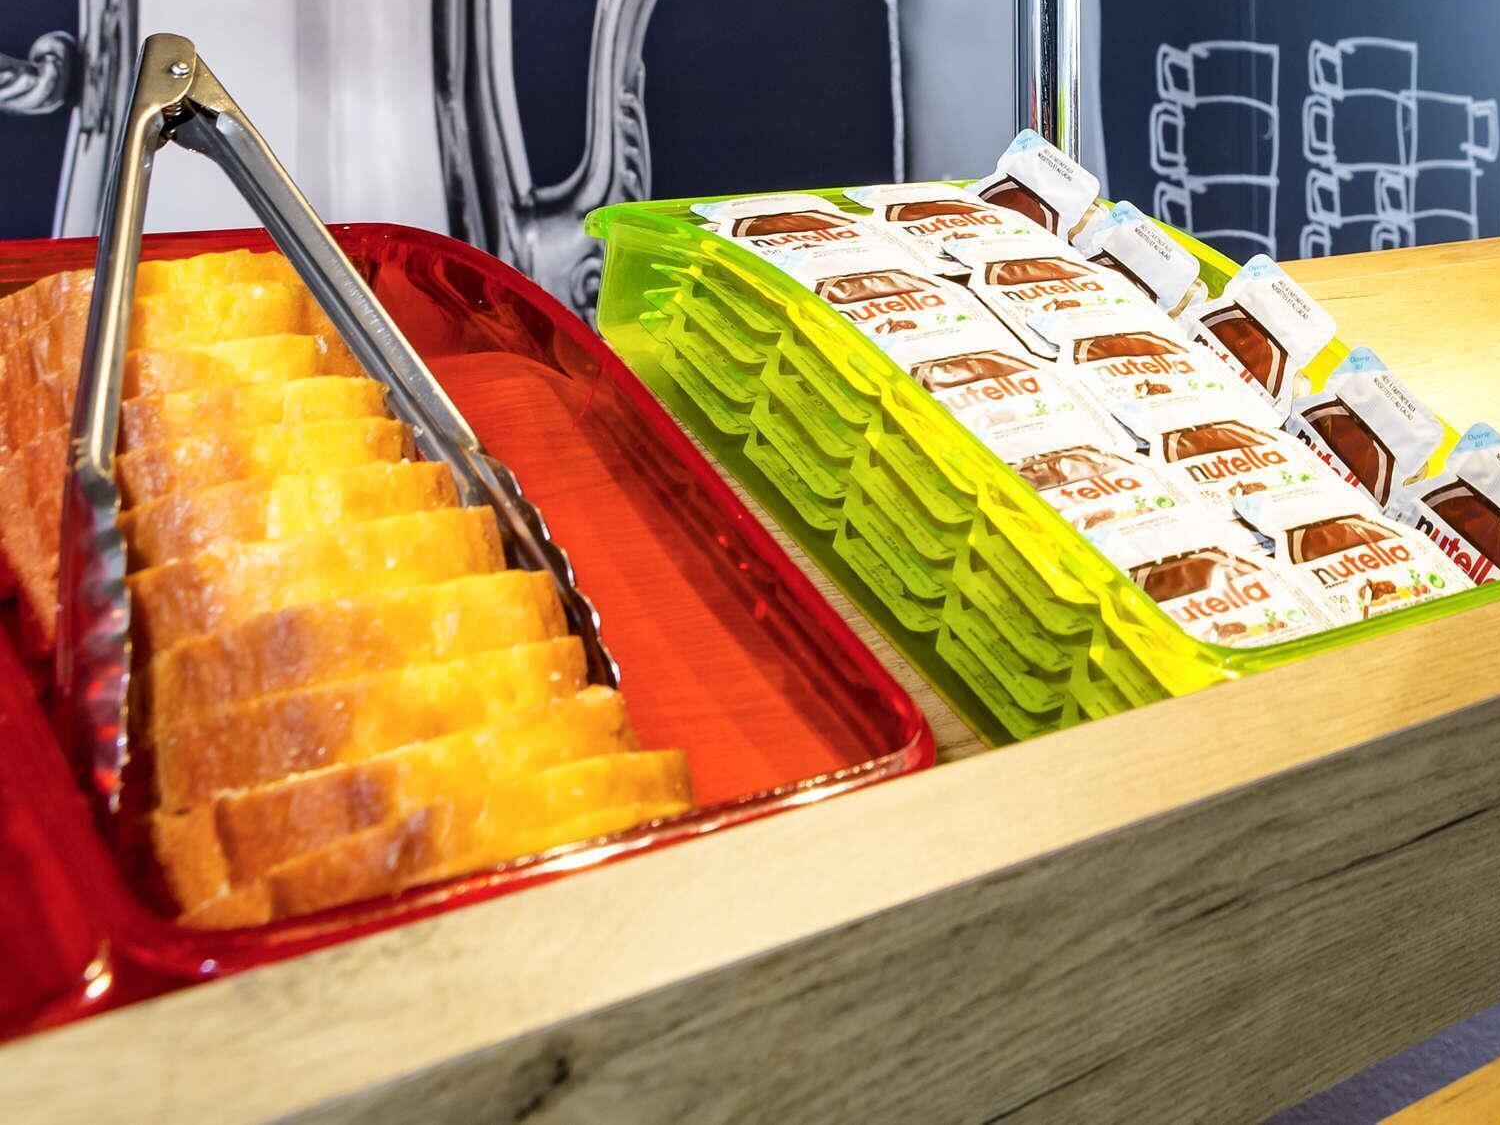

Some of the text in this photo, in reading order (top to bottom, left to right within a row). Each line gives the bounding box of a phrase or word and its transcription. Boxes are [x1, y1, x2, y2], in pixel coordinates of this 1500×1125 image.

[902, 209, 1003, 236] nutella
[1001, 276, 1105, 302] nutella
[1184, 446, 1289, 483] nutella
[1310, 540, 1412, 586] nutella
